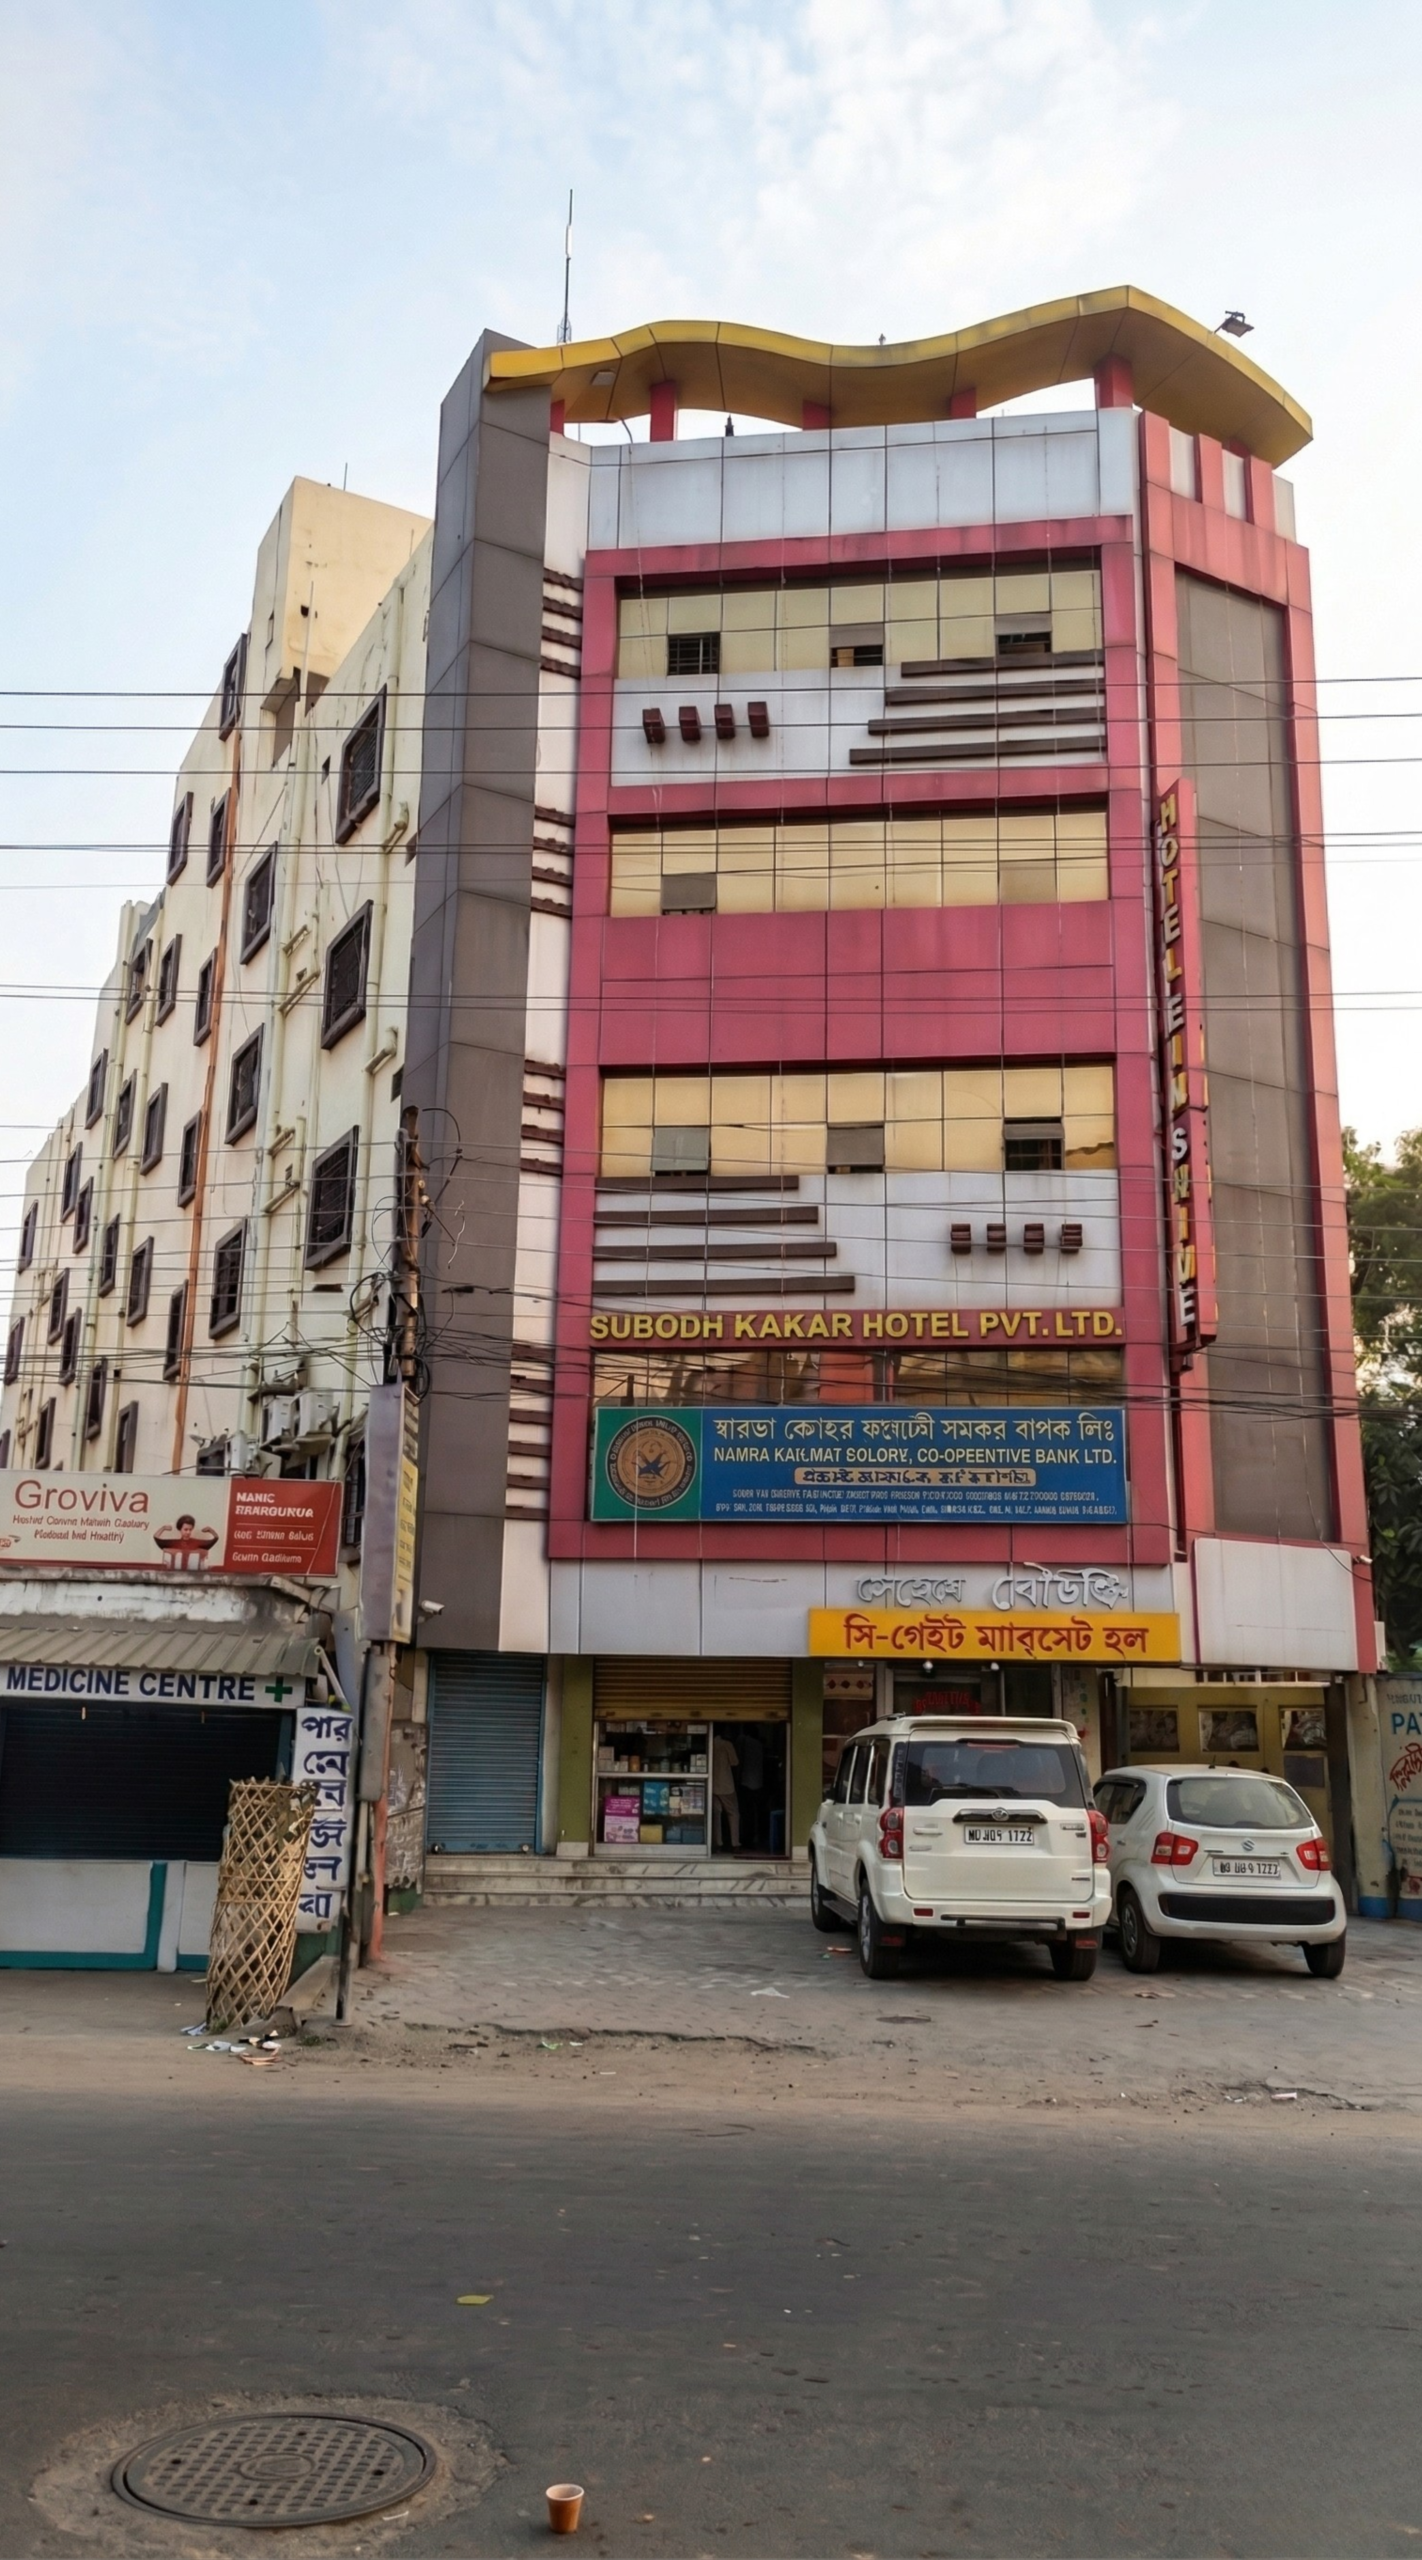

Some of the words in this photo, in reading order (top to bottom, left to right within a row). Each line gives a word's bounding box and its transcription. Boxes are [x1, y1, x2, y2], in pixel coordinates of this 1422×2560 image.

[589, 1313, 724, 1340] SUBODH
[734, 1313, 855, 1339] KAKAR
[862, 1312, 970, 1338] HOTEL
[713, 1447, 770, 1462] NAMRA
[917, 1448, 1031, 1463] CO-OPEENTIVE
[1035, 1448, 1080, 1463] BANK
[1084, 1449, 1117, 1464] LTD.
[14, 1479, 149, 1513] Groviva
[1102, 1626, 1149, 1659] হল
[6, 1666, 130, 1695] MEDICINE
[138, 1672, 256, 1701] CENTRE
